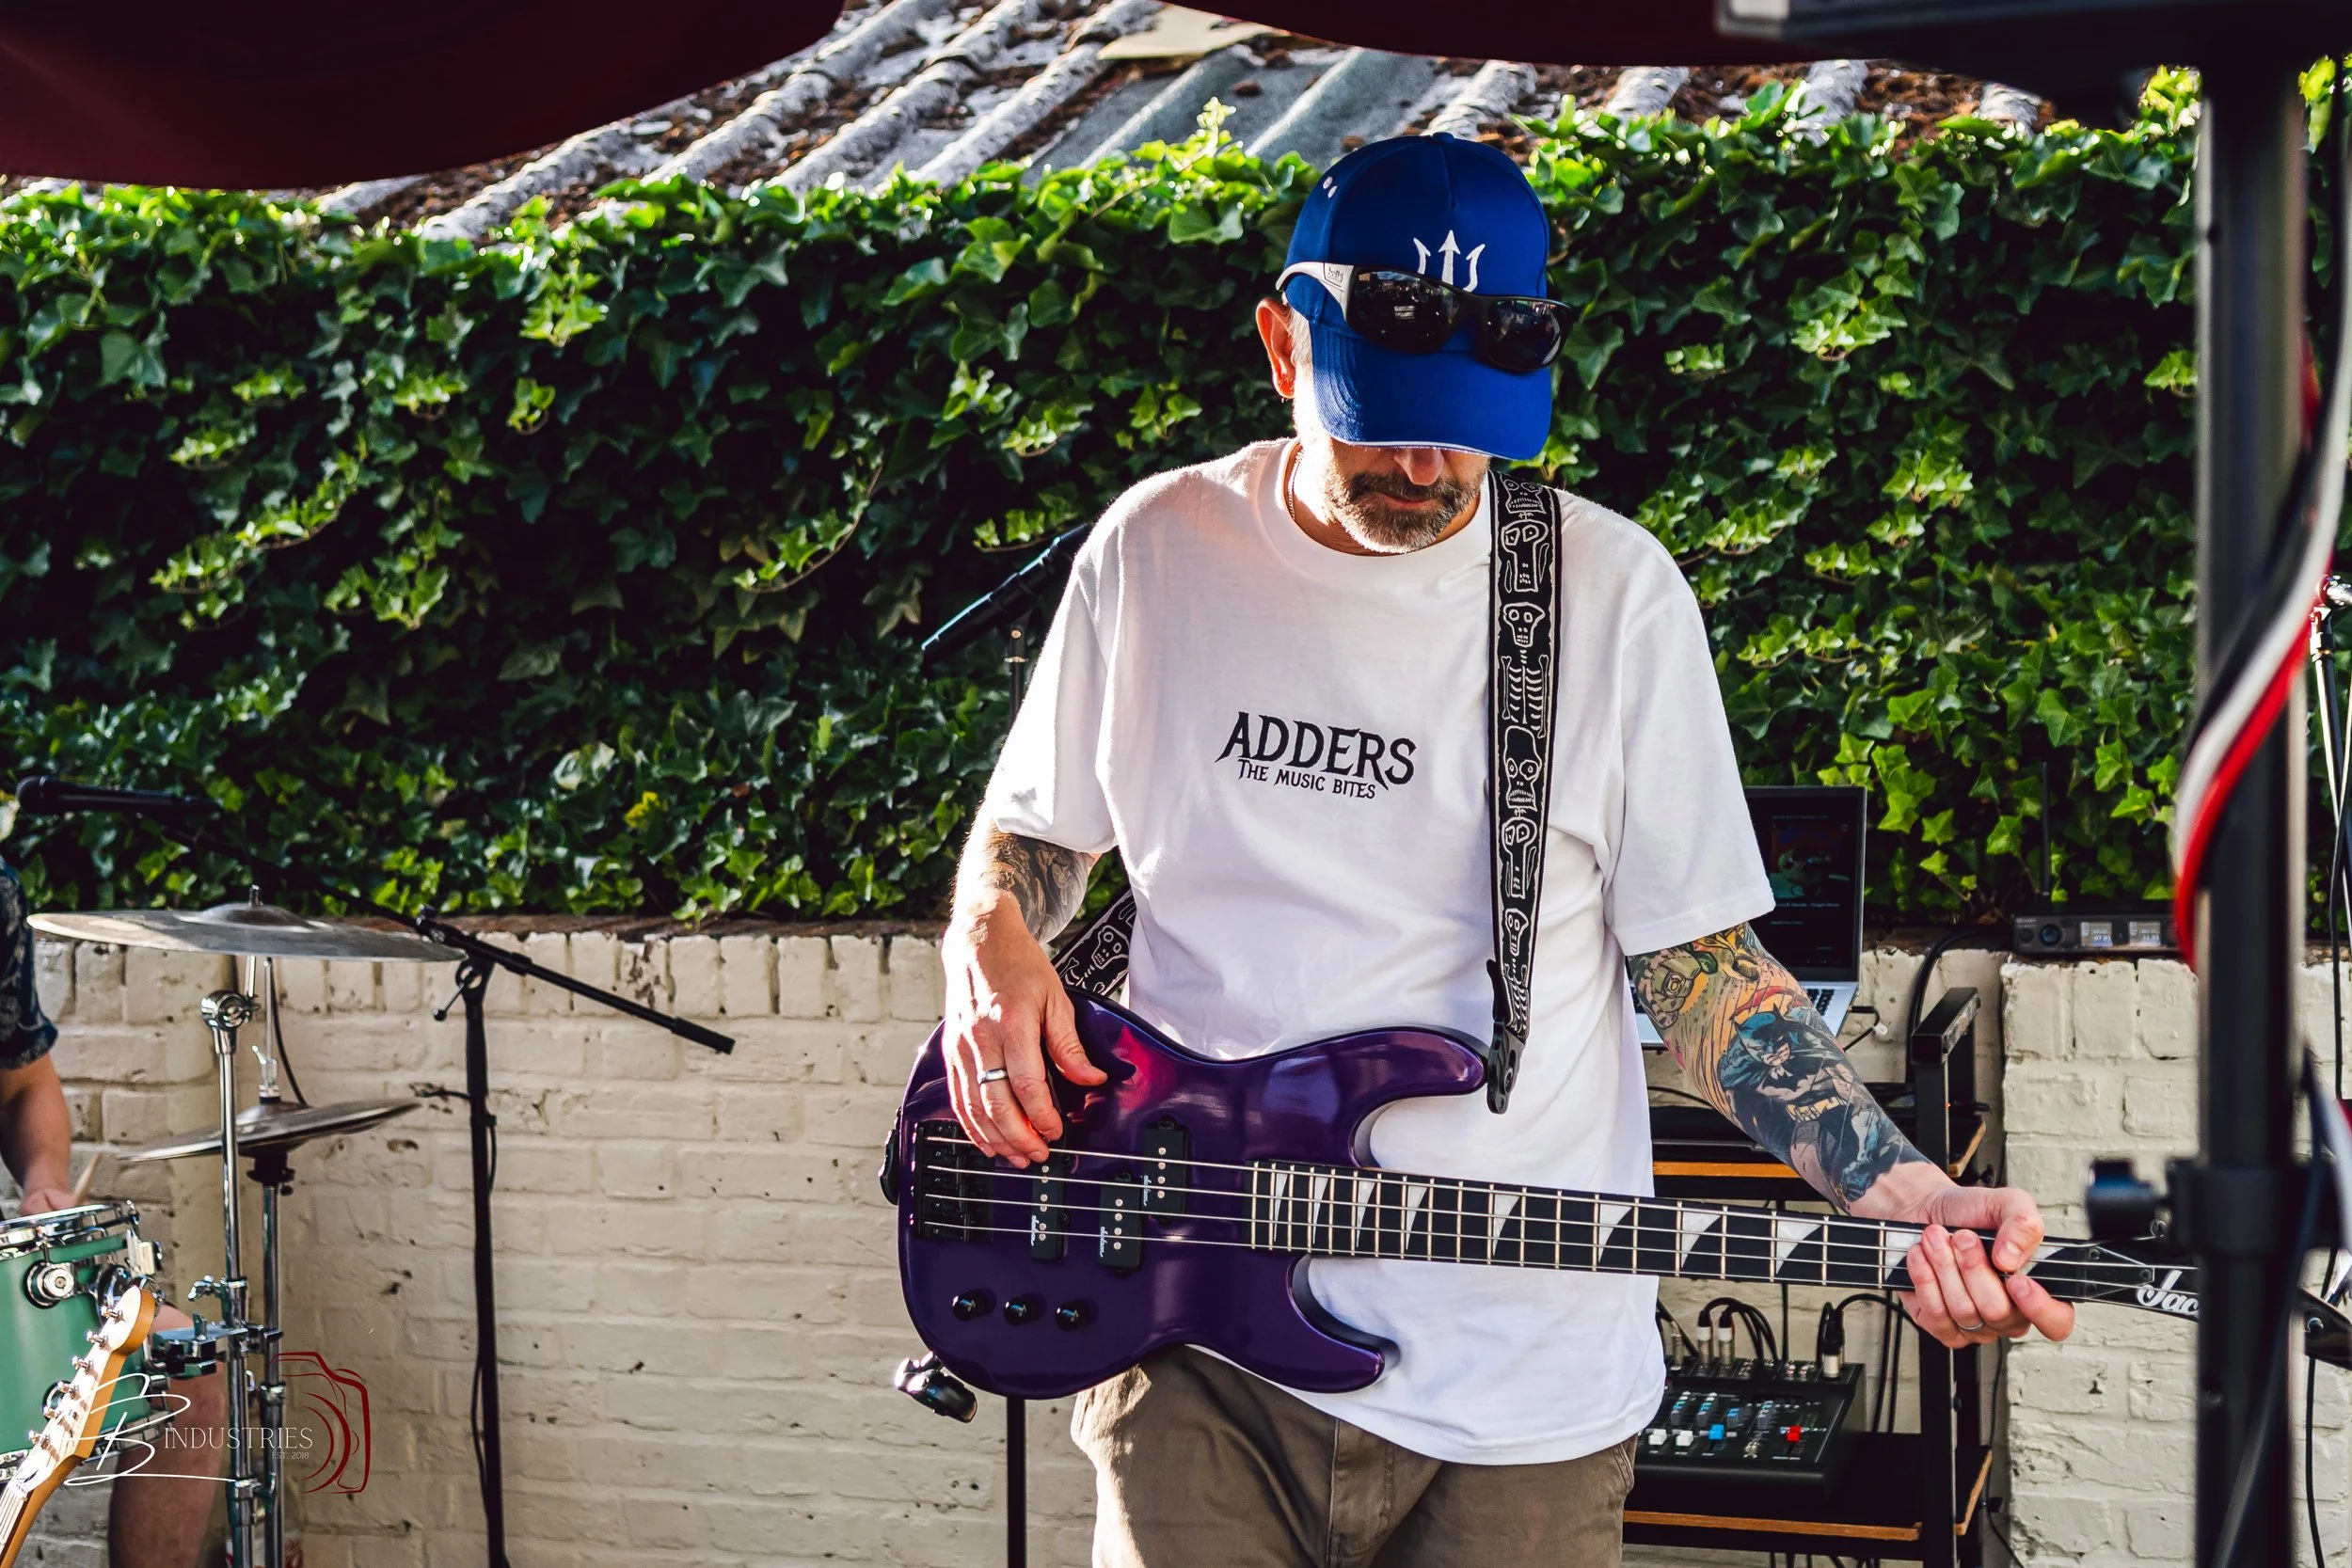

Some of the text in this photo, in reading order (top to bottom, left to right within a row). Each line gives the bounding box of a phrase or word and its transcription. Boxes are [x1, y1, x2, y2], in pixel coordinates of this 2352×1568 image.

[1215, 711, 1417, 791] ADDERS
[1237, 758, 1376, 799] THE MUSIC BITES
[2137, 1270, 2199, 1317] Jac
